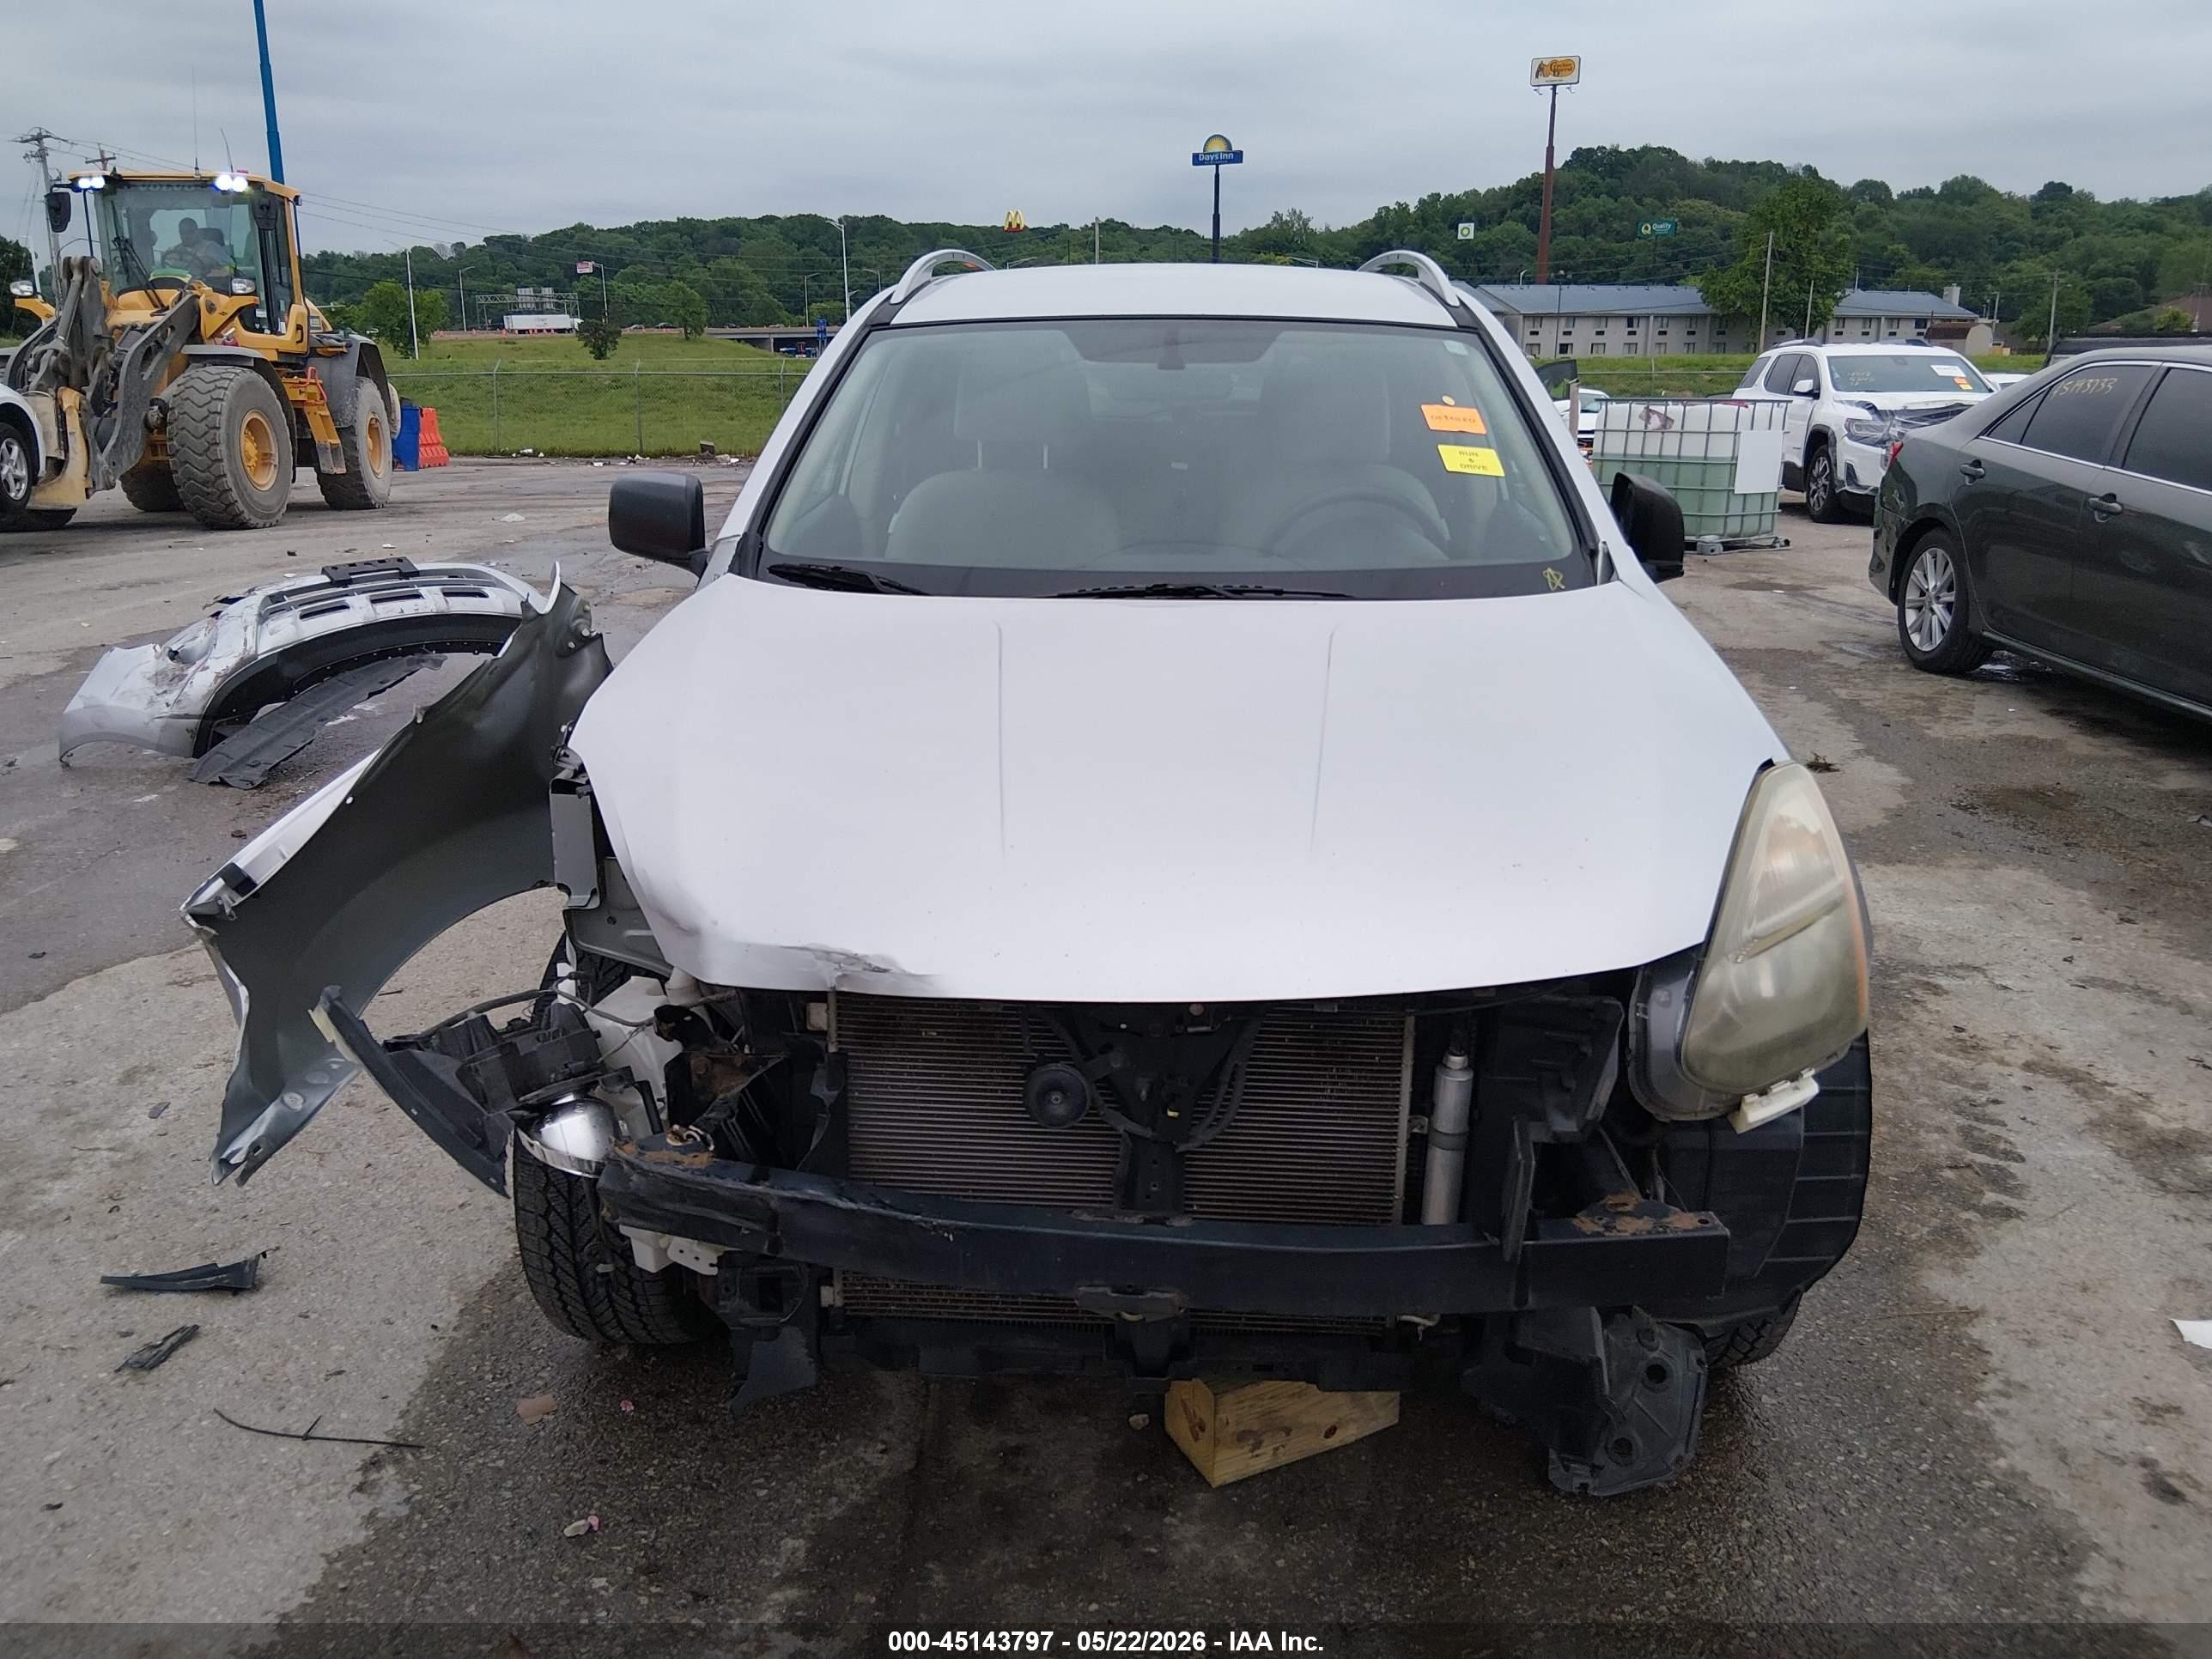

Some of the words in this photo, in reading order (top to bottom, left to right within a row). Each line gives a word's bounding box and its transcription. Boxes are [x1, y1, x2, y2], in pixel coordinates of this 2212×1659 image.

[1199, 153, 1219, 162] Days
[1219, 151, 1234, 160] Inn
[1652, 222, 1672, 231] Quality
[1459, 463, 1489, 471] DRIVE
